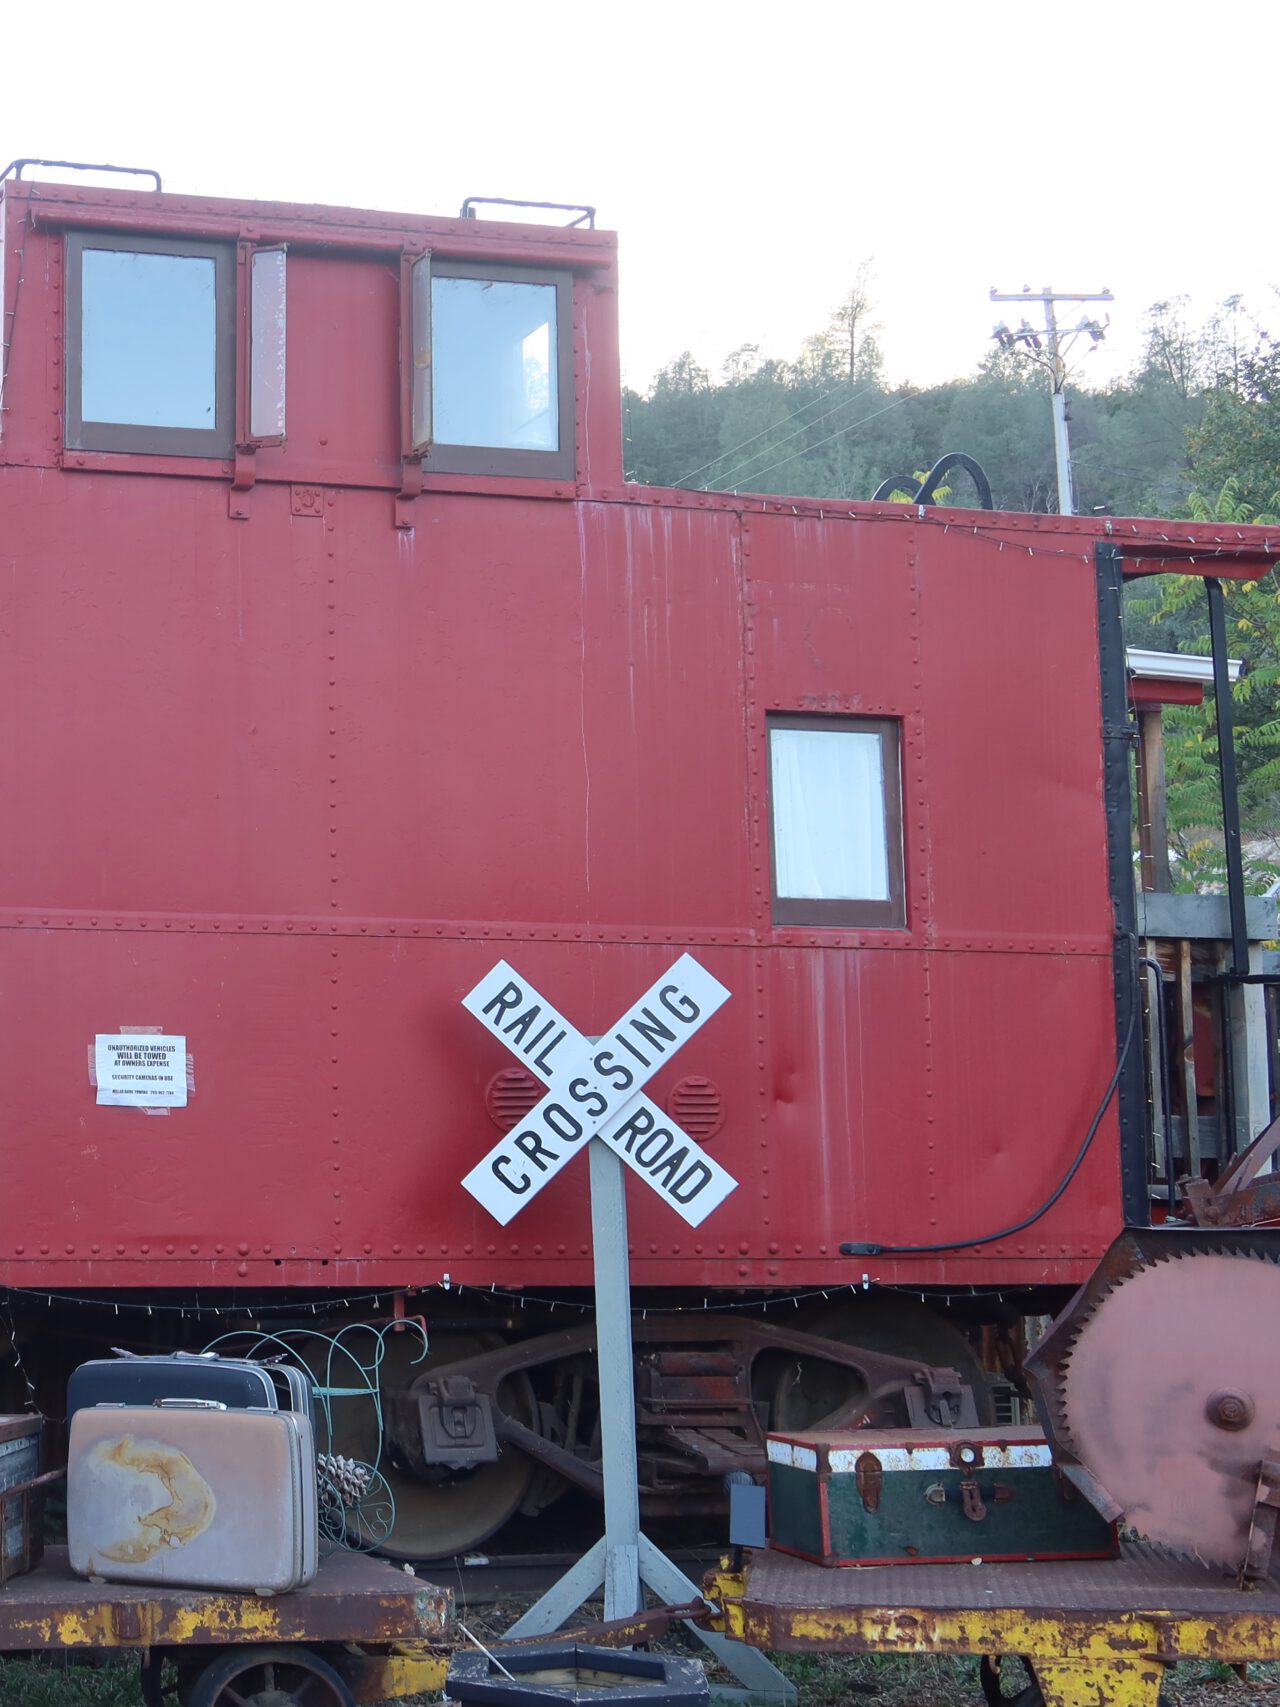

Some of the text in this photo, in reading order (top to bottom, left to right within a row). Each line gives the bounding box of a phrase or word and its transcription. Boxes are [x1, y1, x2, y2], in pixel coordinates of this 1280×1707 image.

[107, 1044, 149, 1052] UNAUTHORIZED
[143, 1052, 167, 1060] TOWED
[481, 980, 713, 1205] RAIL ROAD
[491, 984, 701, 1195] CROSSING
